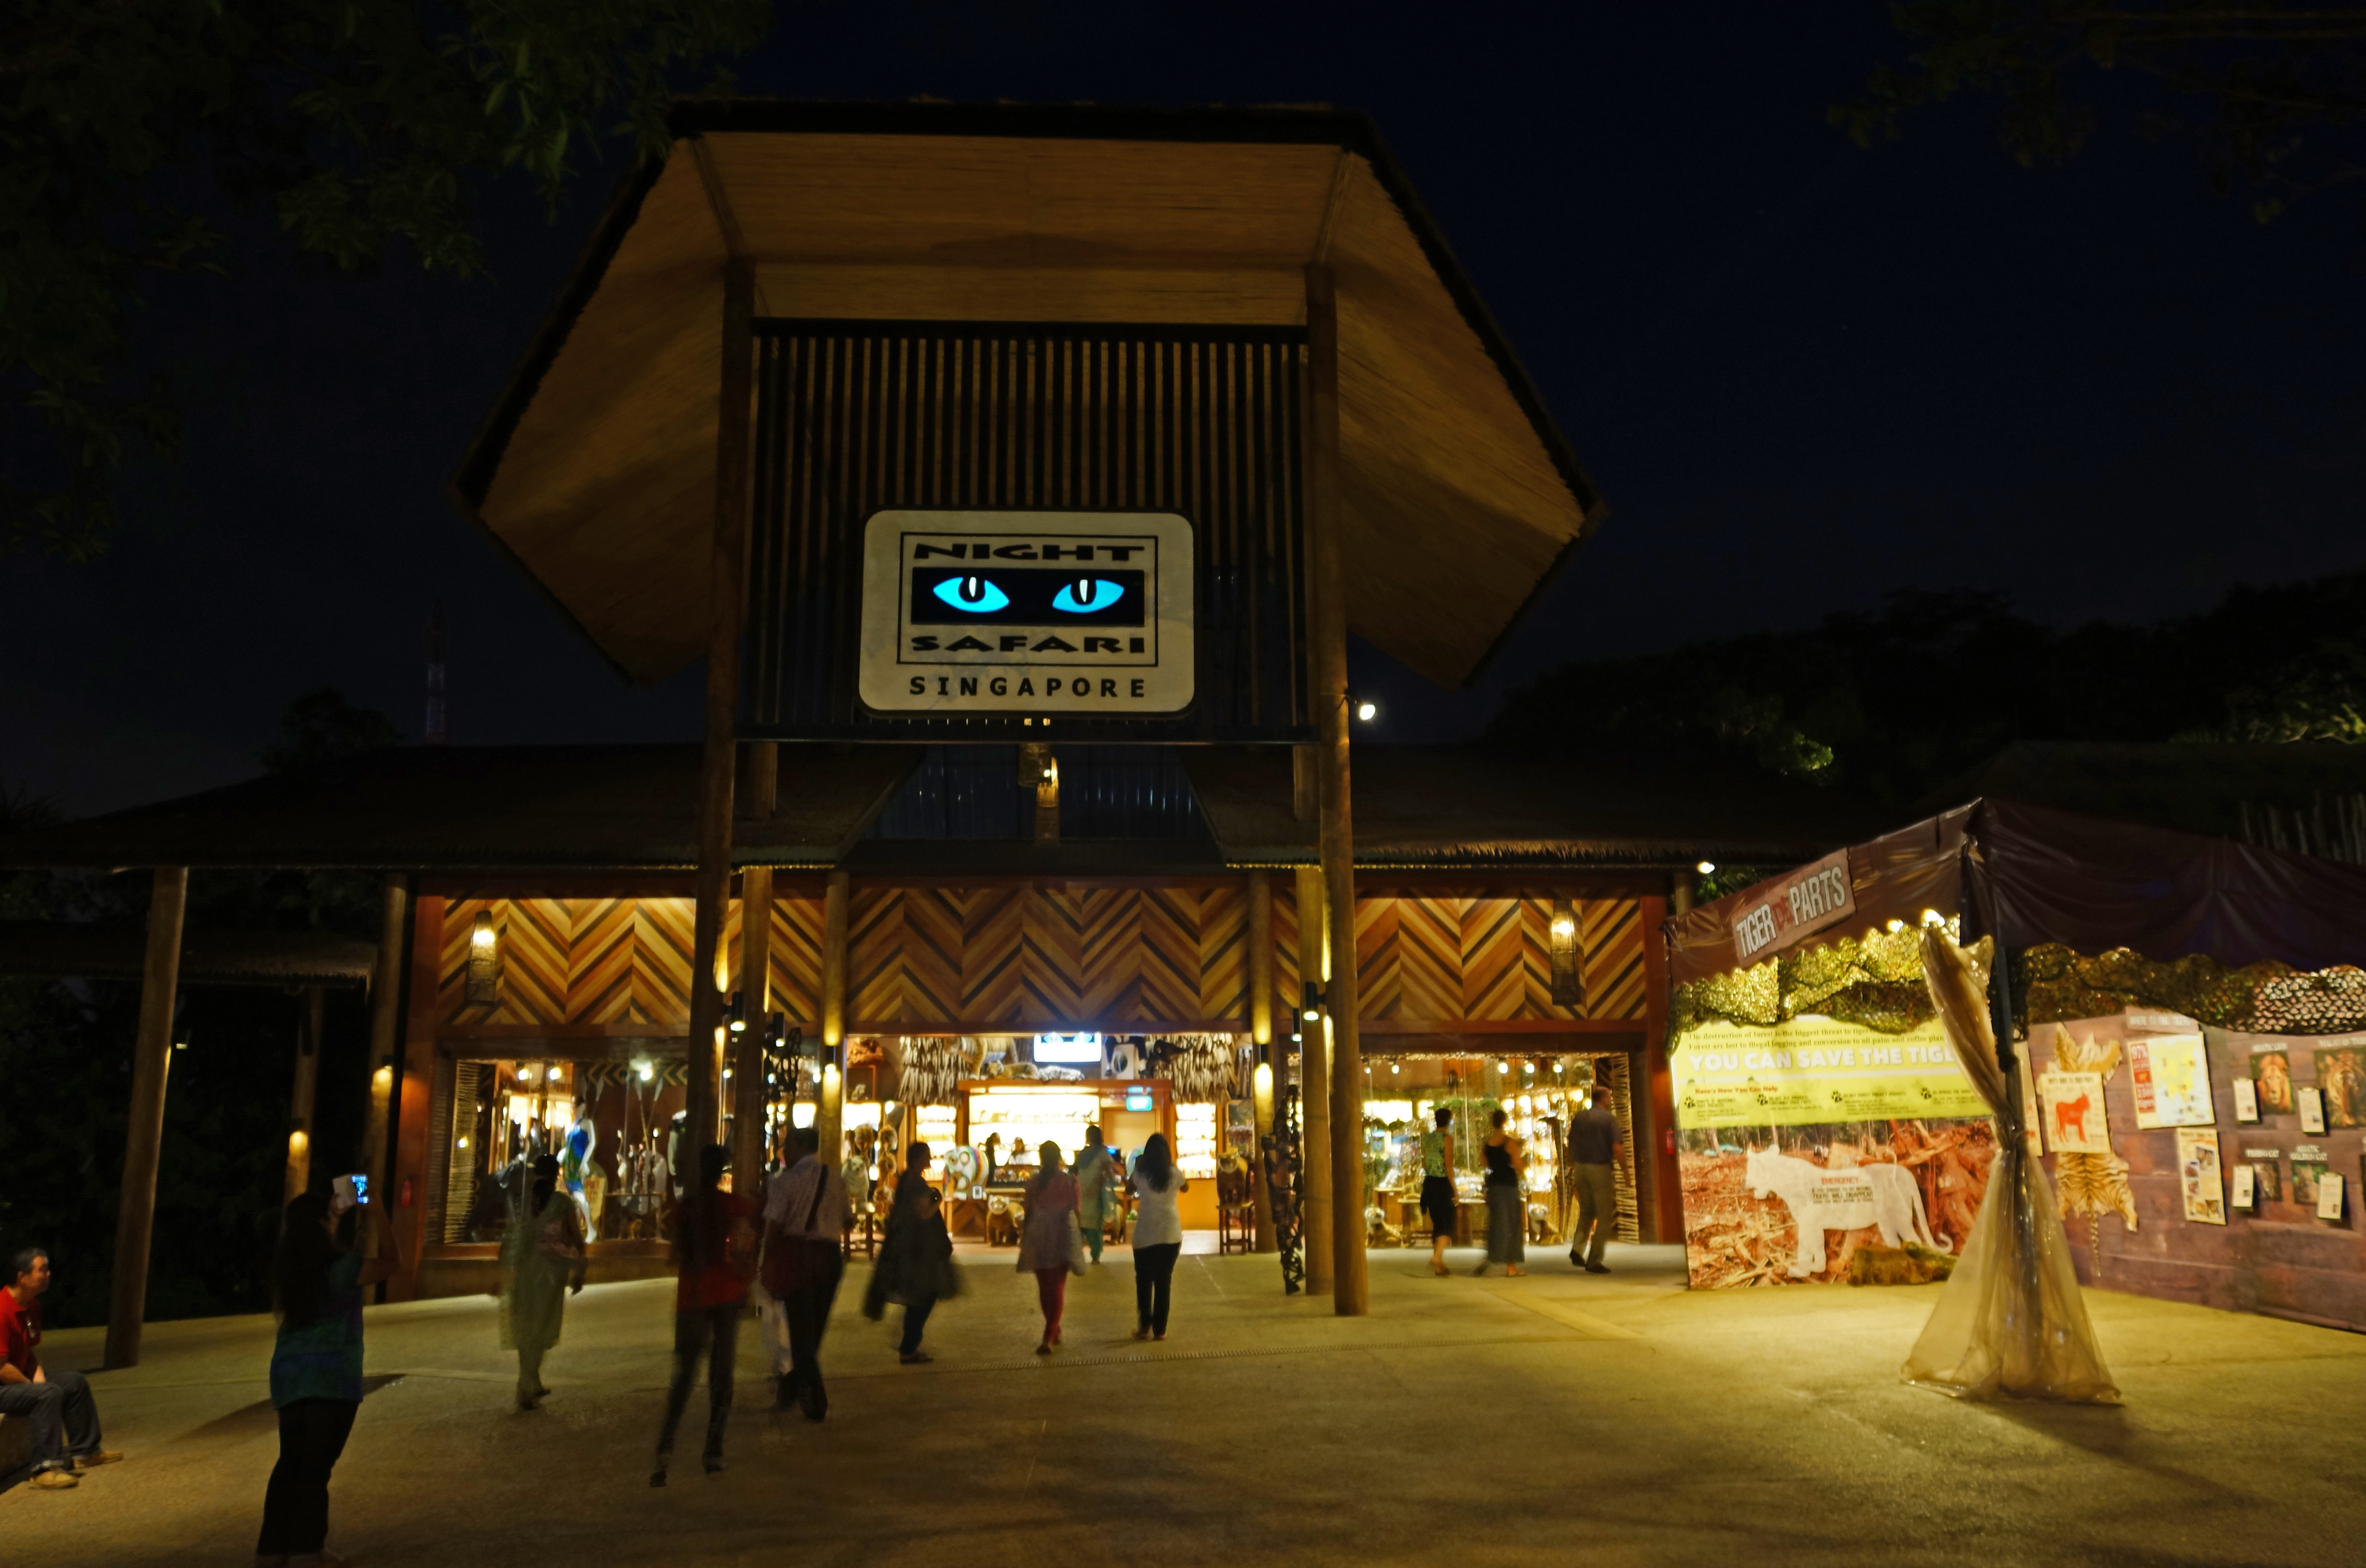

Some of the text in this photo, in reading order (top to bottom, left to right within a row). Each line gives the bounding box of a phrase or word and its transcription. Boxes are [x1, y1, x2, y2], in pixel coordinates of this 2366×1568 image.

[914, 544, 1144, 561] NIGHT
[911, 635, 1144, 653] SAFARI
[910, 676, 1144, 697] SINGAPORE
[1736, 903, 1776, 958] TIGER
[1795, 1029, 1819, 1037] biggest
[1689, 1054, 1739, 1072] YOU
[1745, 1051, 1792, 1070] CAN
[1798, 1049, 1855, 1069] SAVE
[1861, 1047, 1903, 1065] THE
